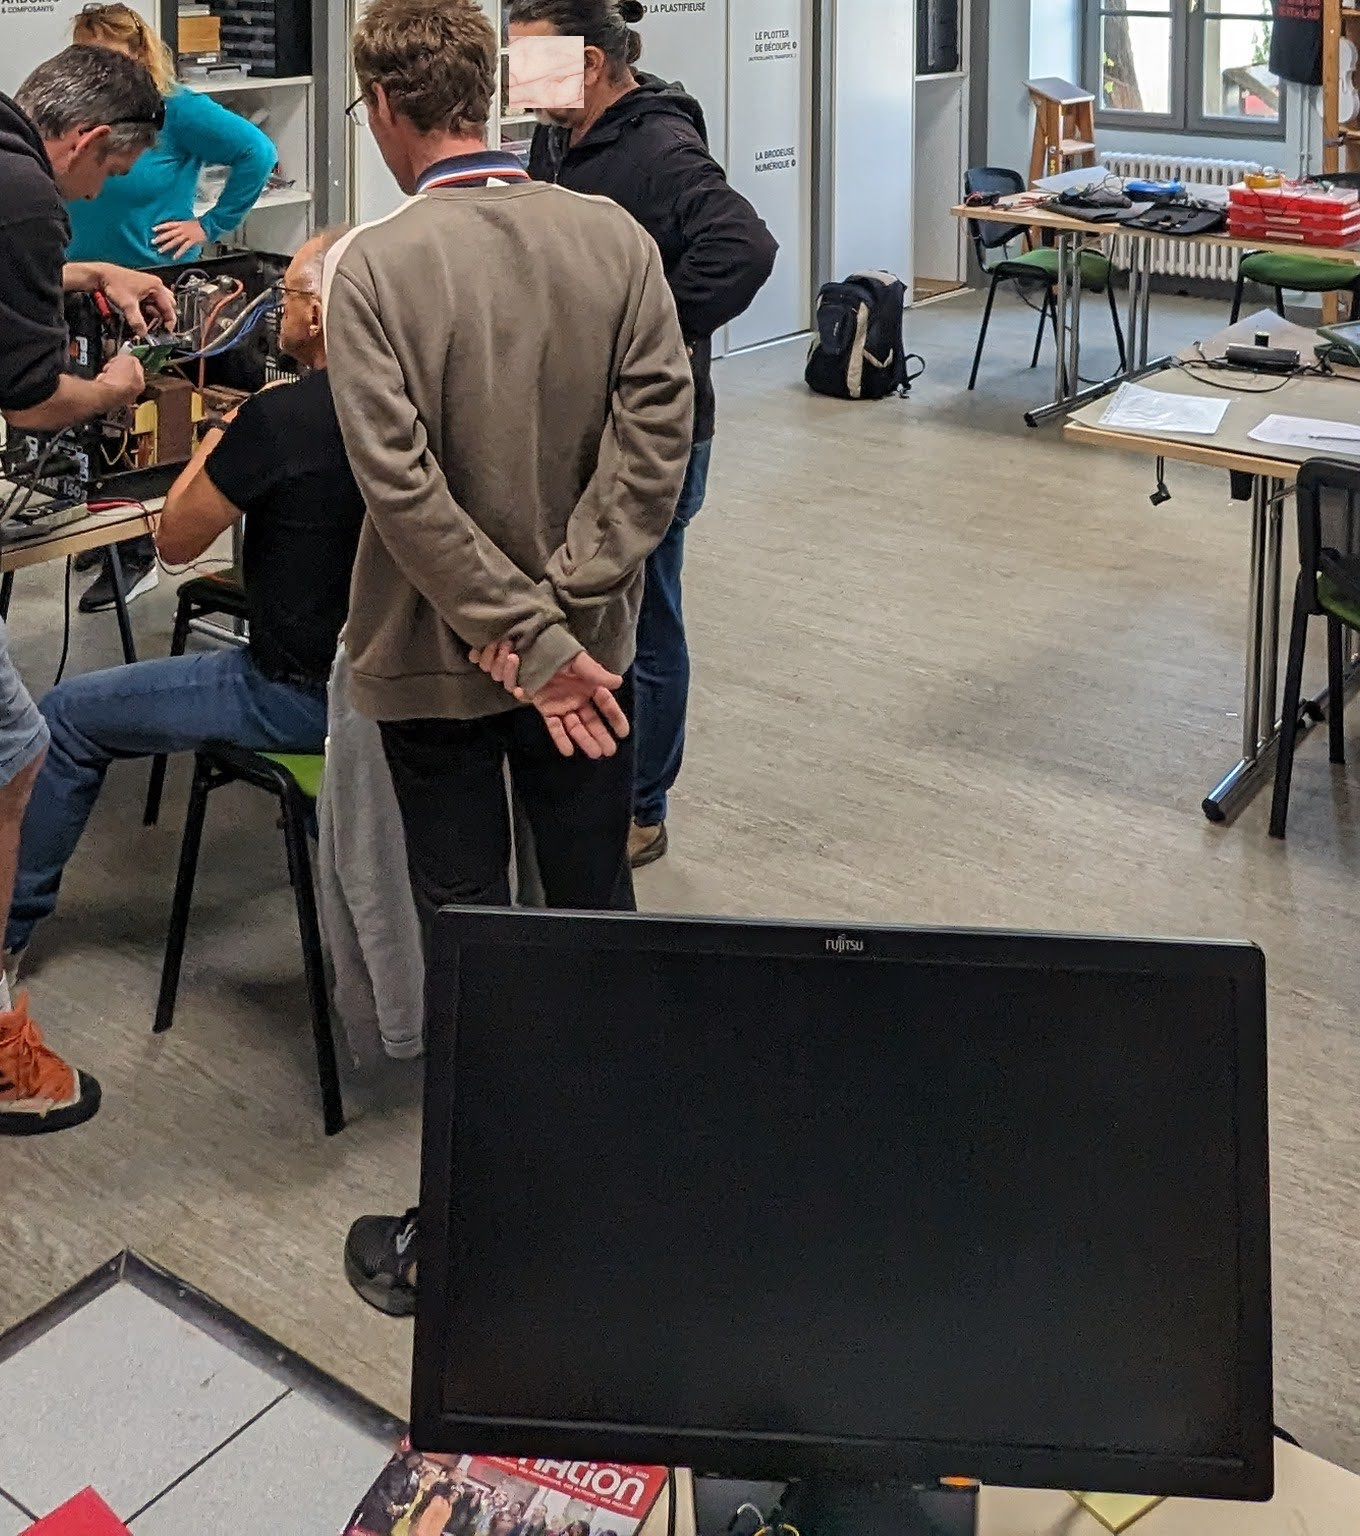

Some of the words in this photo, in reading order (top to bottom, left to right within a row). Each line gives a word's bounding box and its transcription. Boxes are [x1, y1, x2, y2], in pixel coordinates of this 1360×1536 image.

[650, 5, 659, 14] LA
[660, 2, 706, 13] PLASTIFIEUSE
[764, 30, 789, 40] PLOTTER
[764, 147, 795, 159] BRODEUSE
[825, 933, 864, 953] FUJITSU
